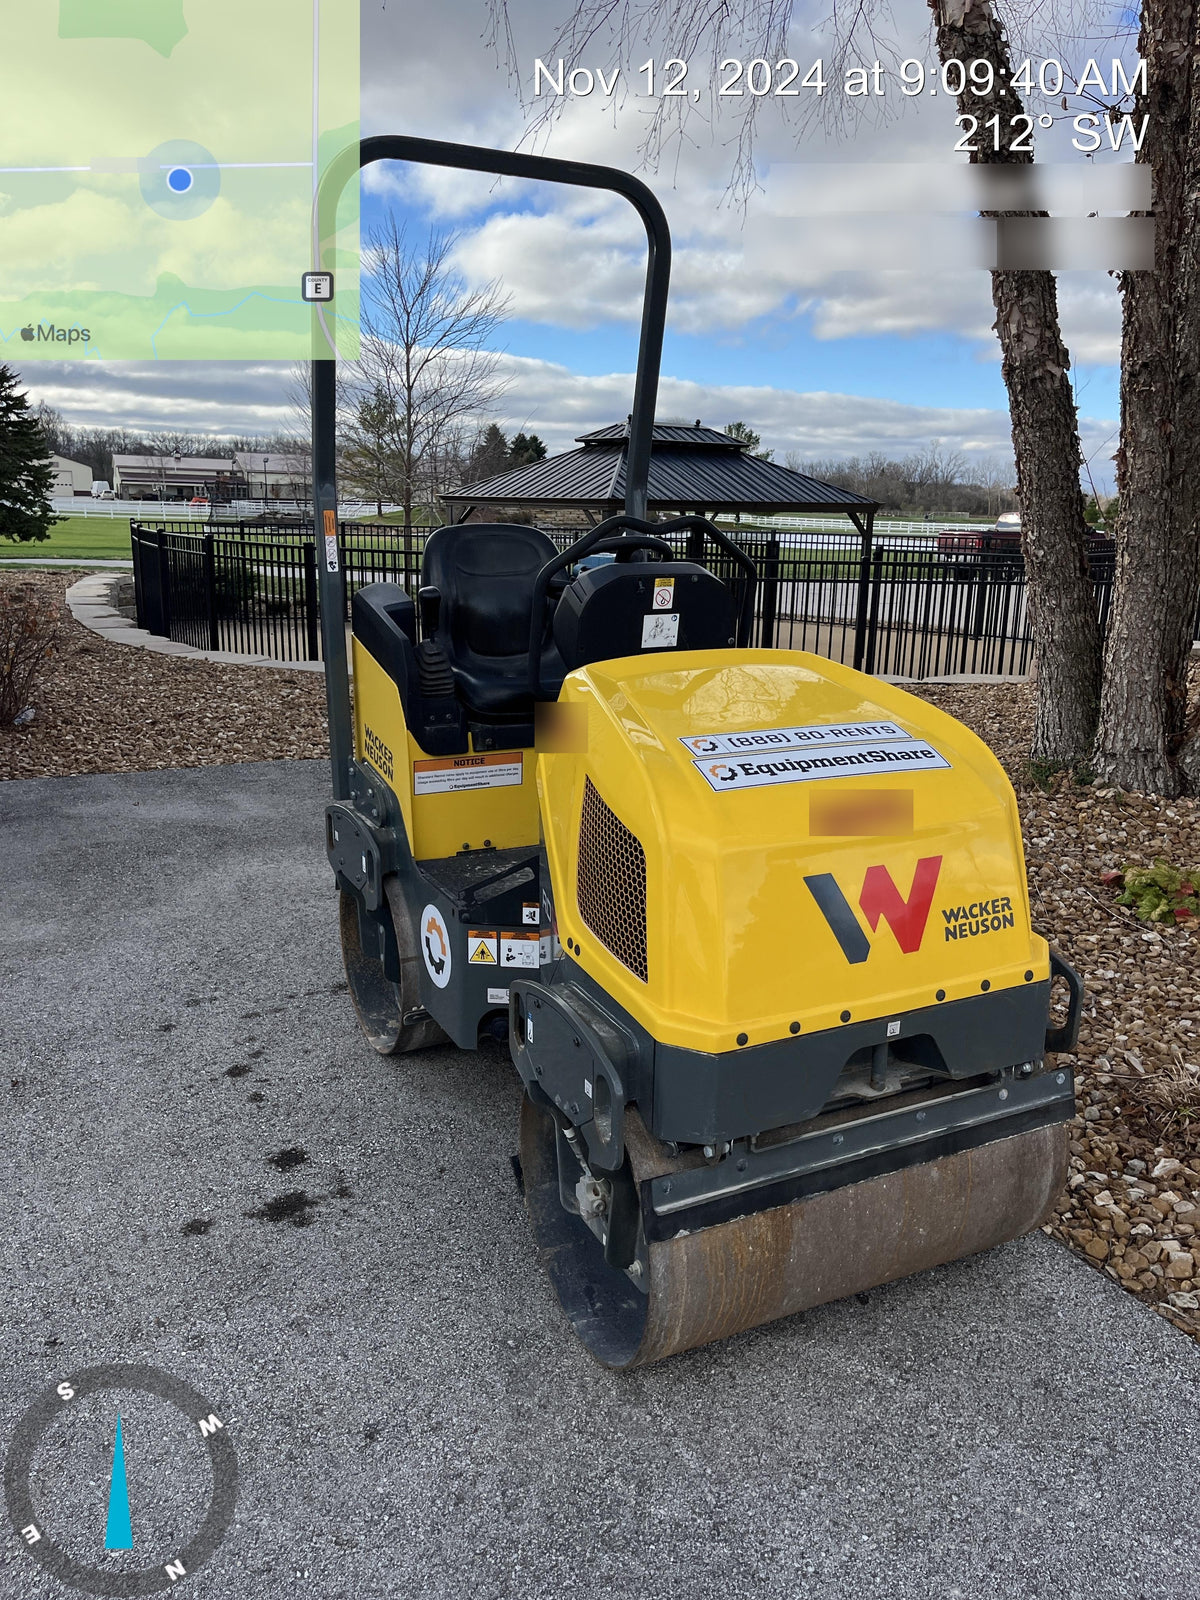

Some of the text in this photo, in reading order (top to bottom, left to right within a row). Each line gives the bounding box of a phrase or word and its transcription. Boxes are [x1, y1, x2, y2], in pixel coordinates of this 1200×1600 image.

[364, 723, 394, 768] WACKER
[727, 733, 790, 748] (888)
[364, 739, 394, 783] NEUSON
[453, 757, 486, 767] NOTICE
[737, 747, 936, 776] EquipmentShare
[942, 897, 1013, 924] WACKER
[944, 913, 1015, 942] NEUSON
